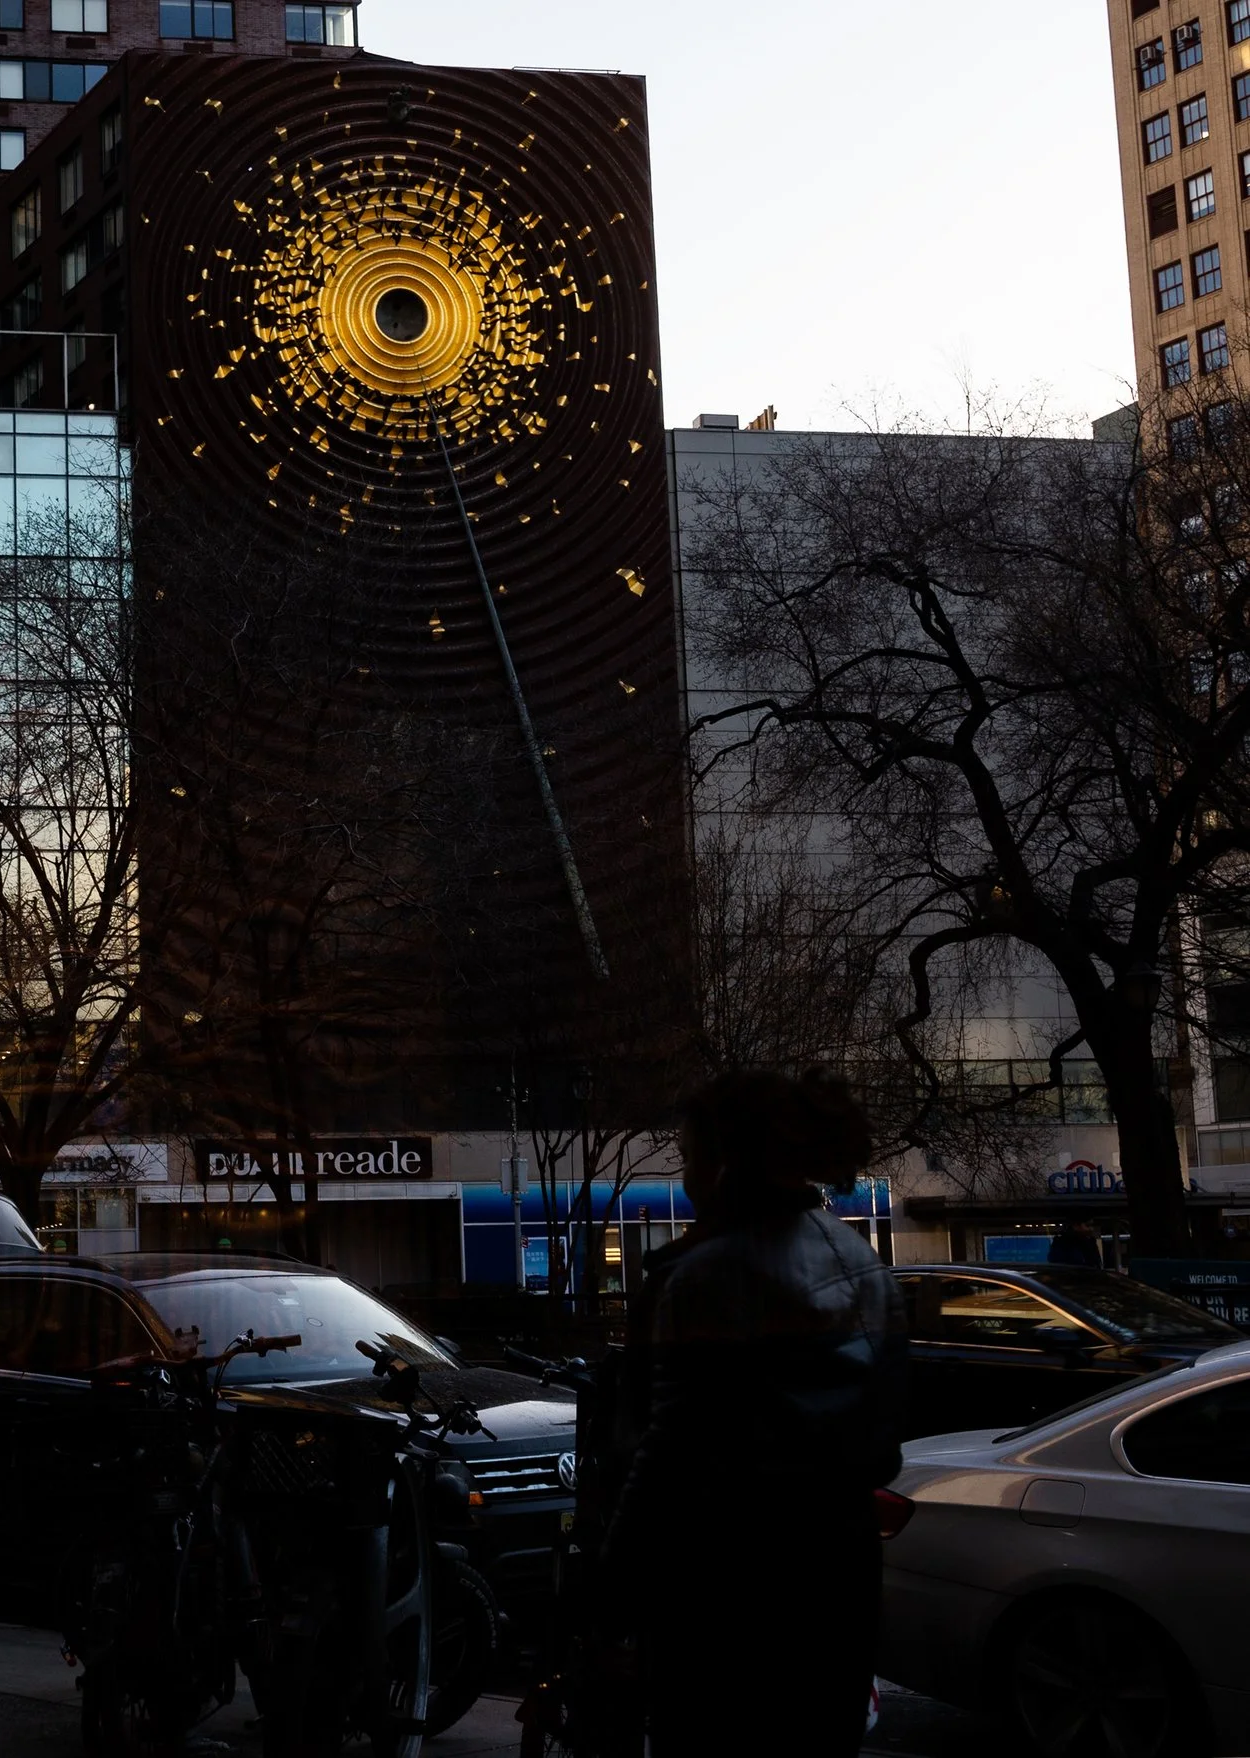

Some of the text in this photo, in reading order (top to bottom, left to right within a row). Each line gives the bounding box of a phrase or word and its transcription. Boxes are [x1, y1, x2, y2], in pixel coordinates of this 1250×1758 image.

[48, 1156, 135, 1181] armacy
[315, 1139, 421, 1175] reade
[1048, 1164, 1127, 1194] citiba
[1188, 1274, 1238, 1284] WELCOME TO
